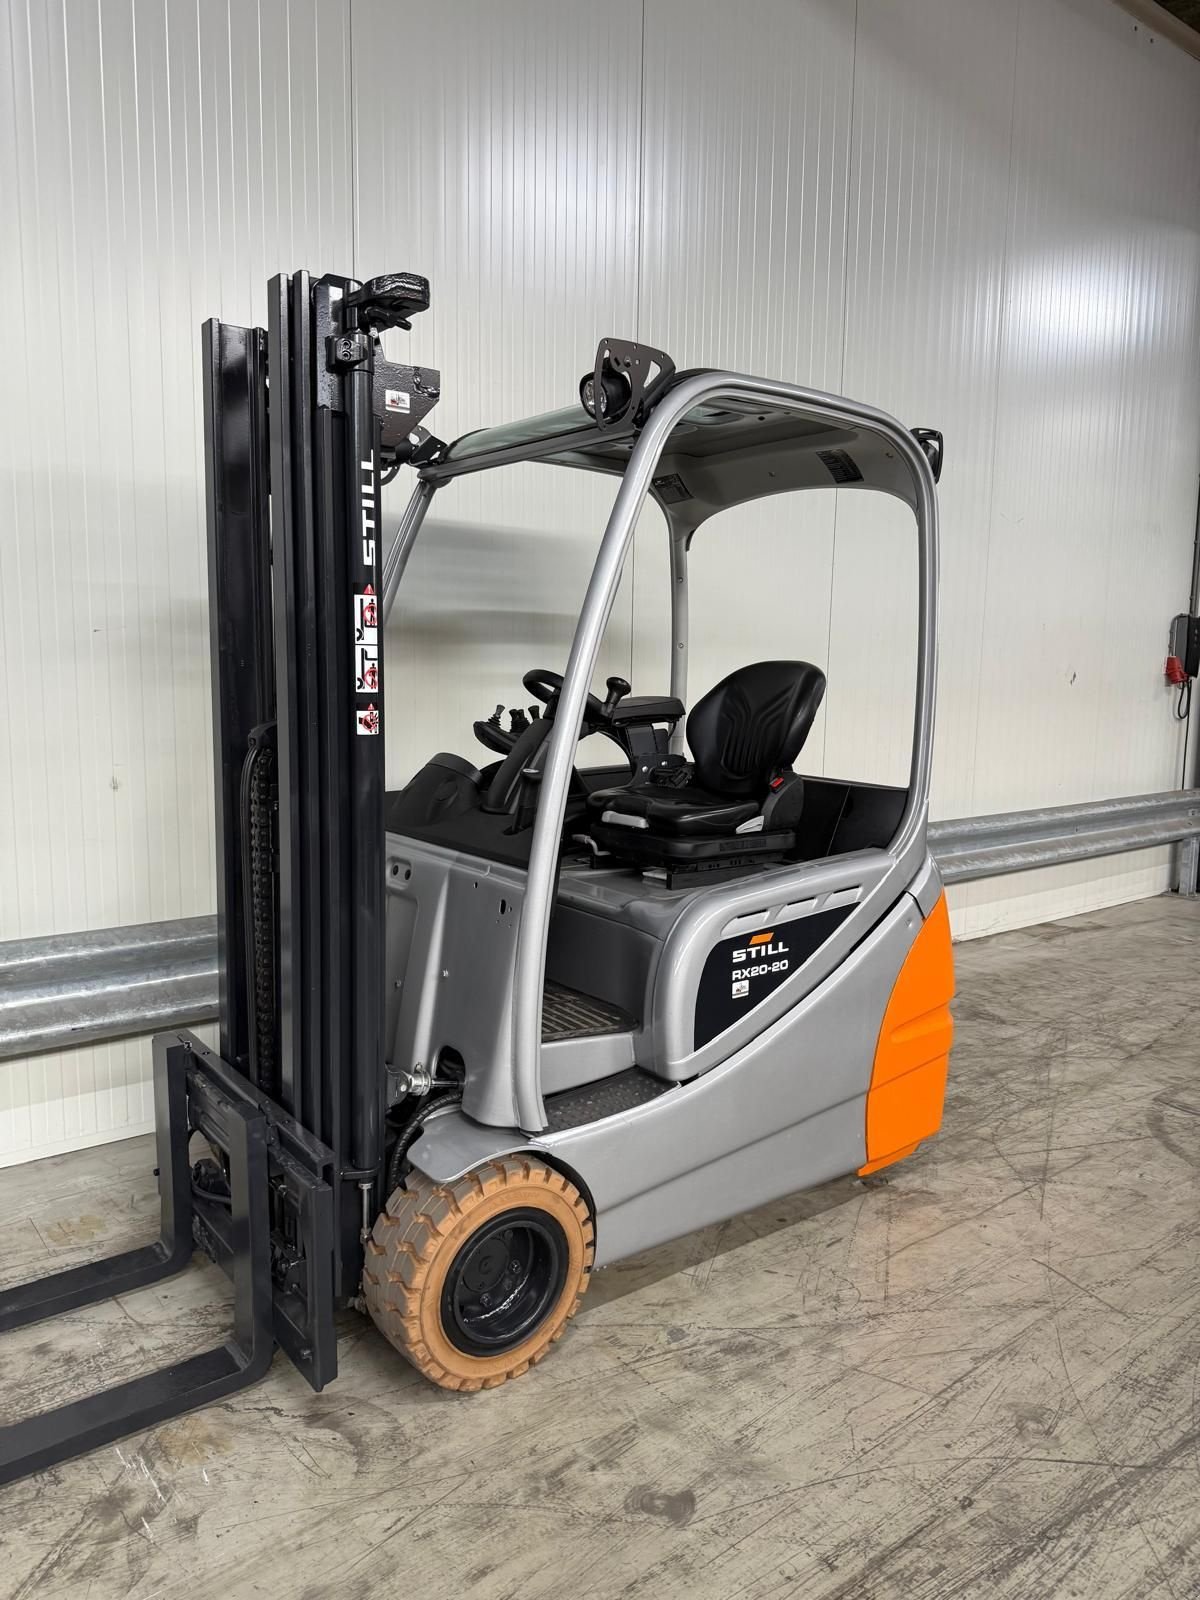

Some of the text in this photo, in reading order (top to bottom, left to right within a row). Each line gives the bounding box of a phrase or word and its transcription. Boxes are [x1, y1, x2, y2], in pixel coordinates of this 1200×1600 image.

[361, 448, 376, 567] STILL
[732, 941, 790, 963] STILL
[732, 959, 789, 981] RX20-20
